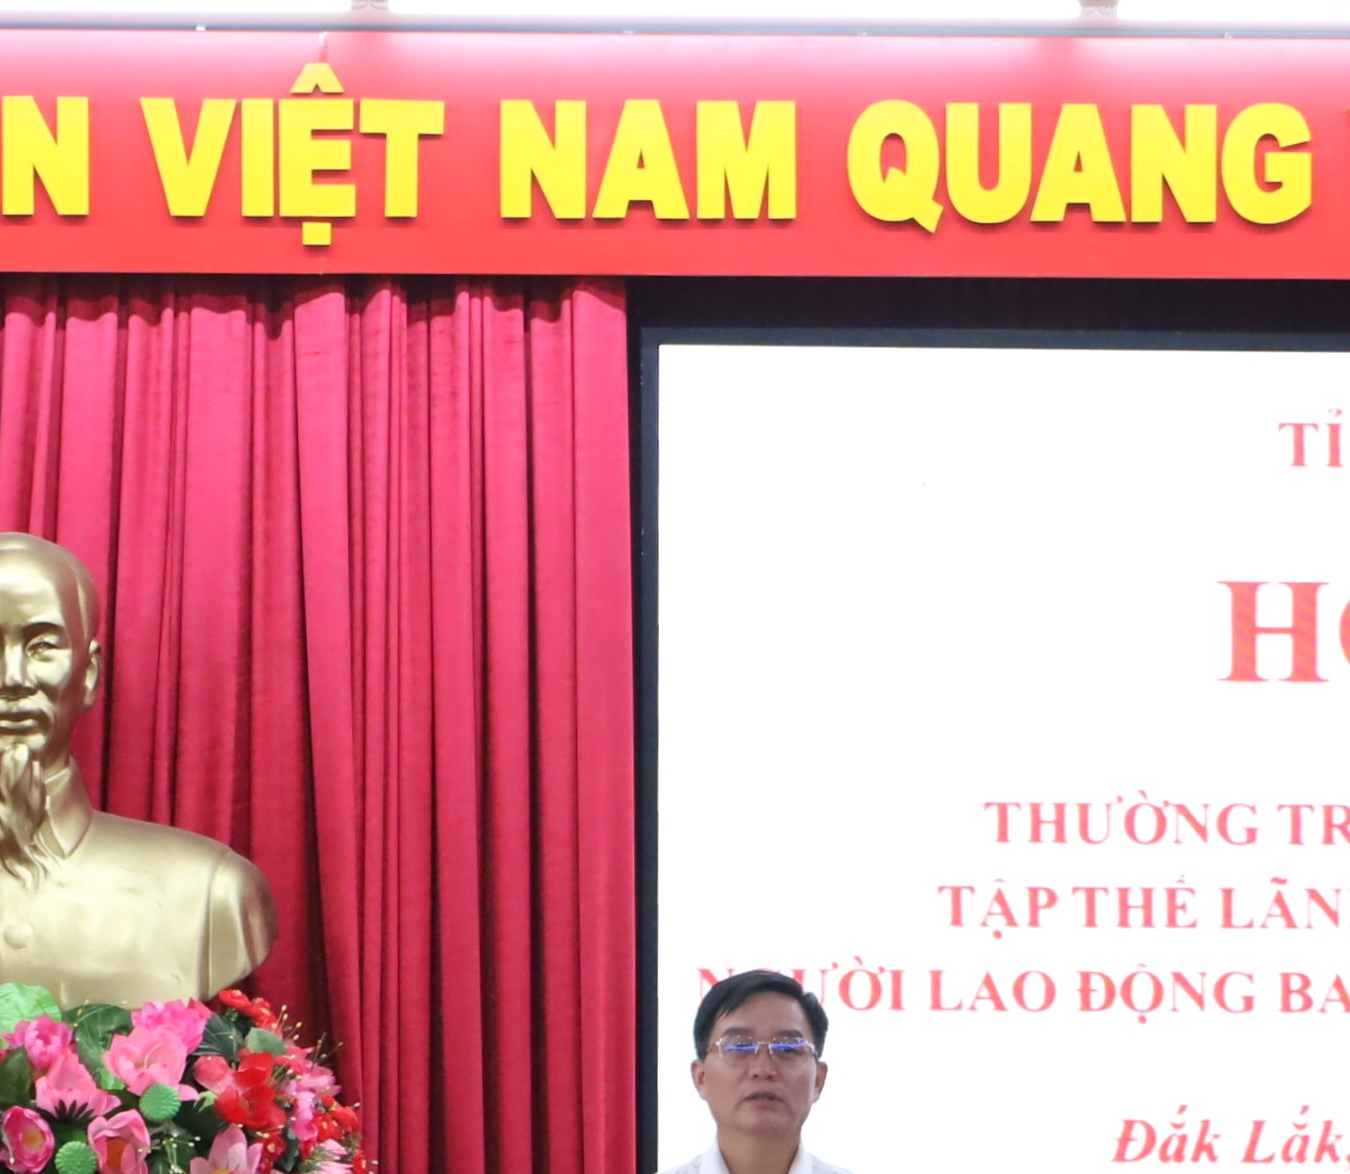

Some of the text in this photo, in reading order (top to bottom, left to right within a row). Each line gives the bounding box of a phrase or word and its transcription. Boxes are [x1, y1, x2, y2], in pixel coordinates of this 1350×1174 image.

[141, 61, 446, 246] VIỆT
[499, 99, 798, 220] NAM
[847, 99, 1313, 234] QUANG
[983, 789, 1259, 847] THƯỜNG
[937, 878, 1059, 940] TẬP
[1071, 874, 1198, 930] THỂ
[928, 969, 1058, 1013] LAO
[1076, 963, 1256, 1025] ĐỘNG
[1112, 1104, 1221, 1164] Đắk
